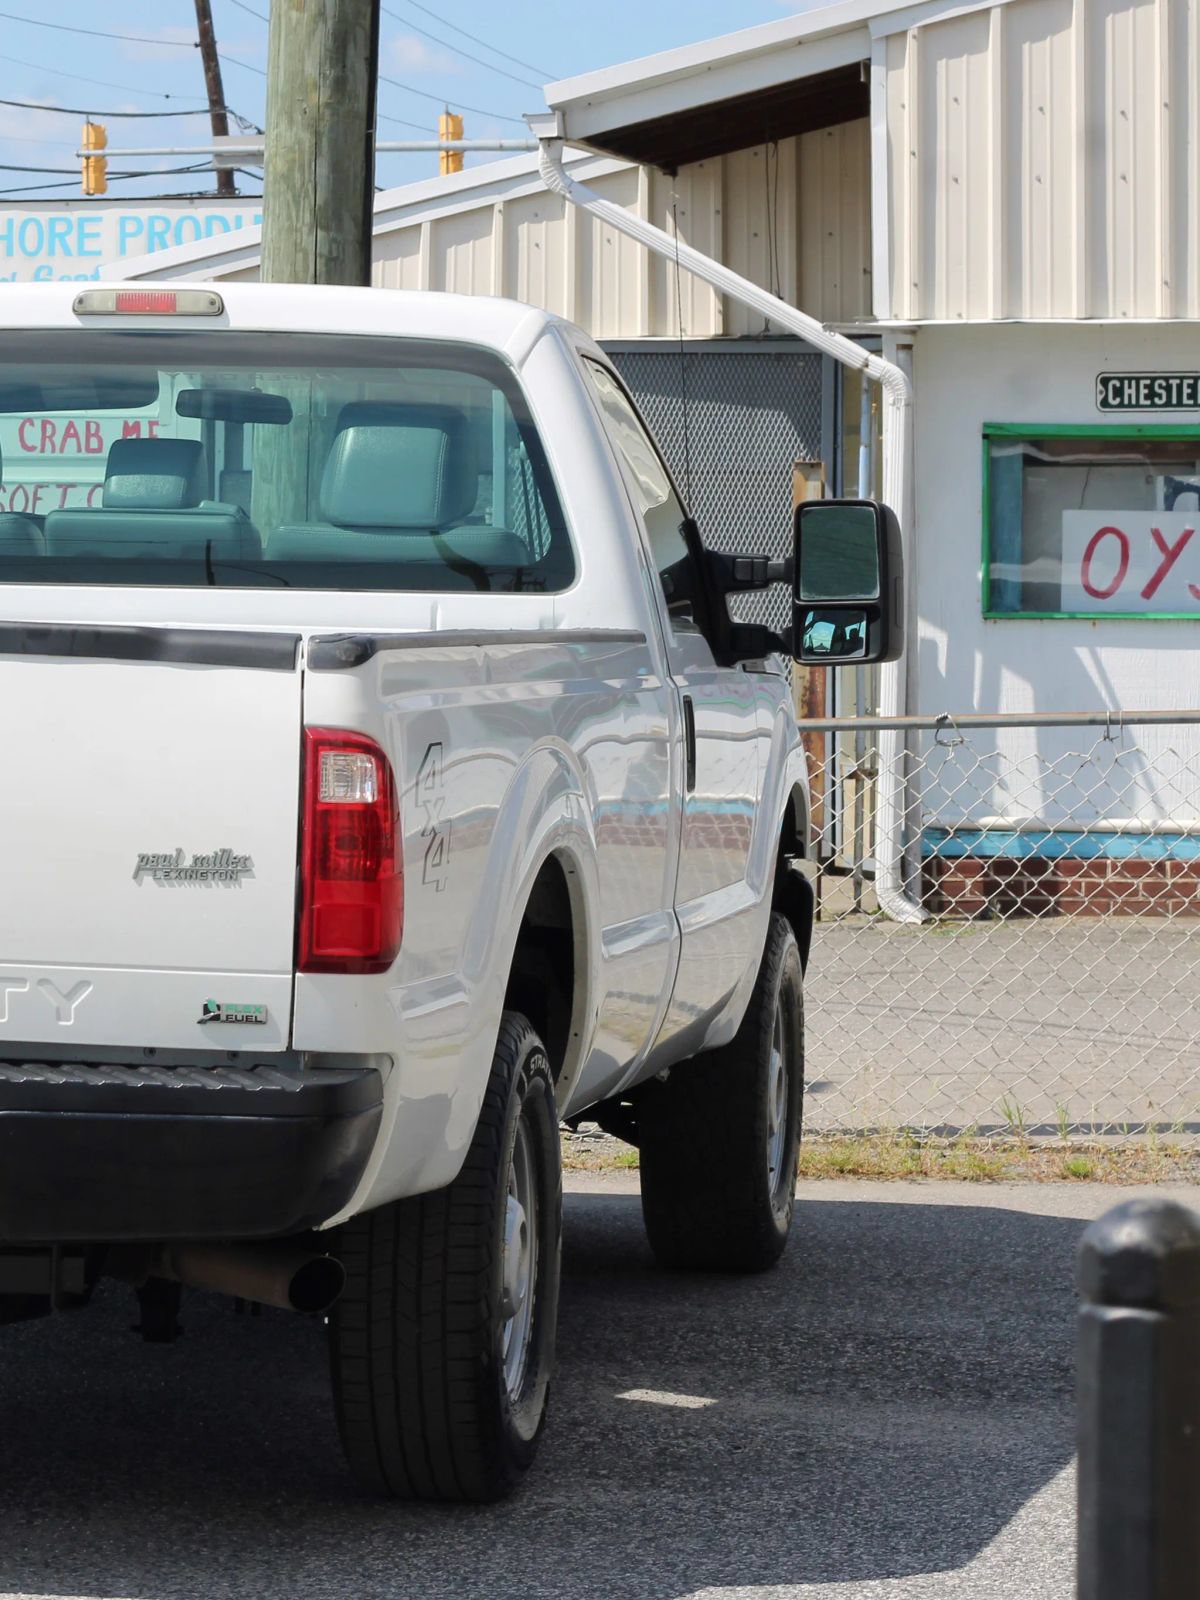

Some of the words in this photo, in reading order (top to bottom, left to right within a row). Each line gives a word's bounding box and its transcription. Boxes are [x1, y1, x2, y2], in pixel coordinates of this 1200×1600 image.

[1107, 379, 1200, 405] CHESTE
[18, 417, 104, 453] CRAB
[1081, 526, 1200, 600] OY
[189, 848, 253, 869] miller
[152, 869, 240, 881] LEXINGTON
[224, 1003, 263, 1014] FLEX
[225, 1014, 264, 1024] FUEL
